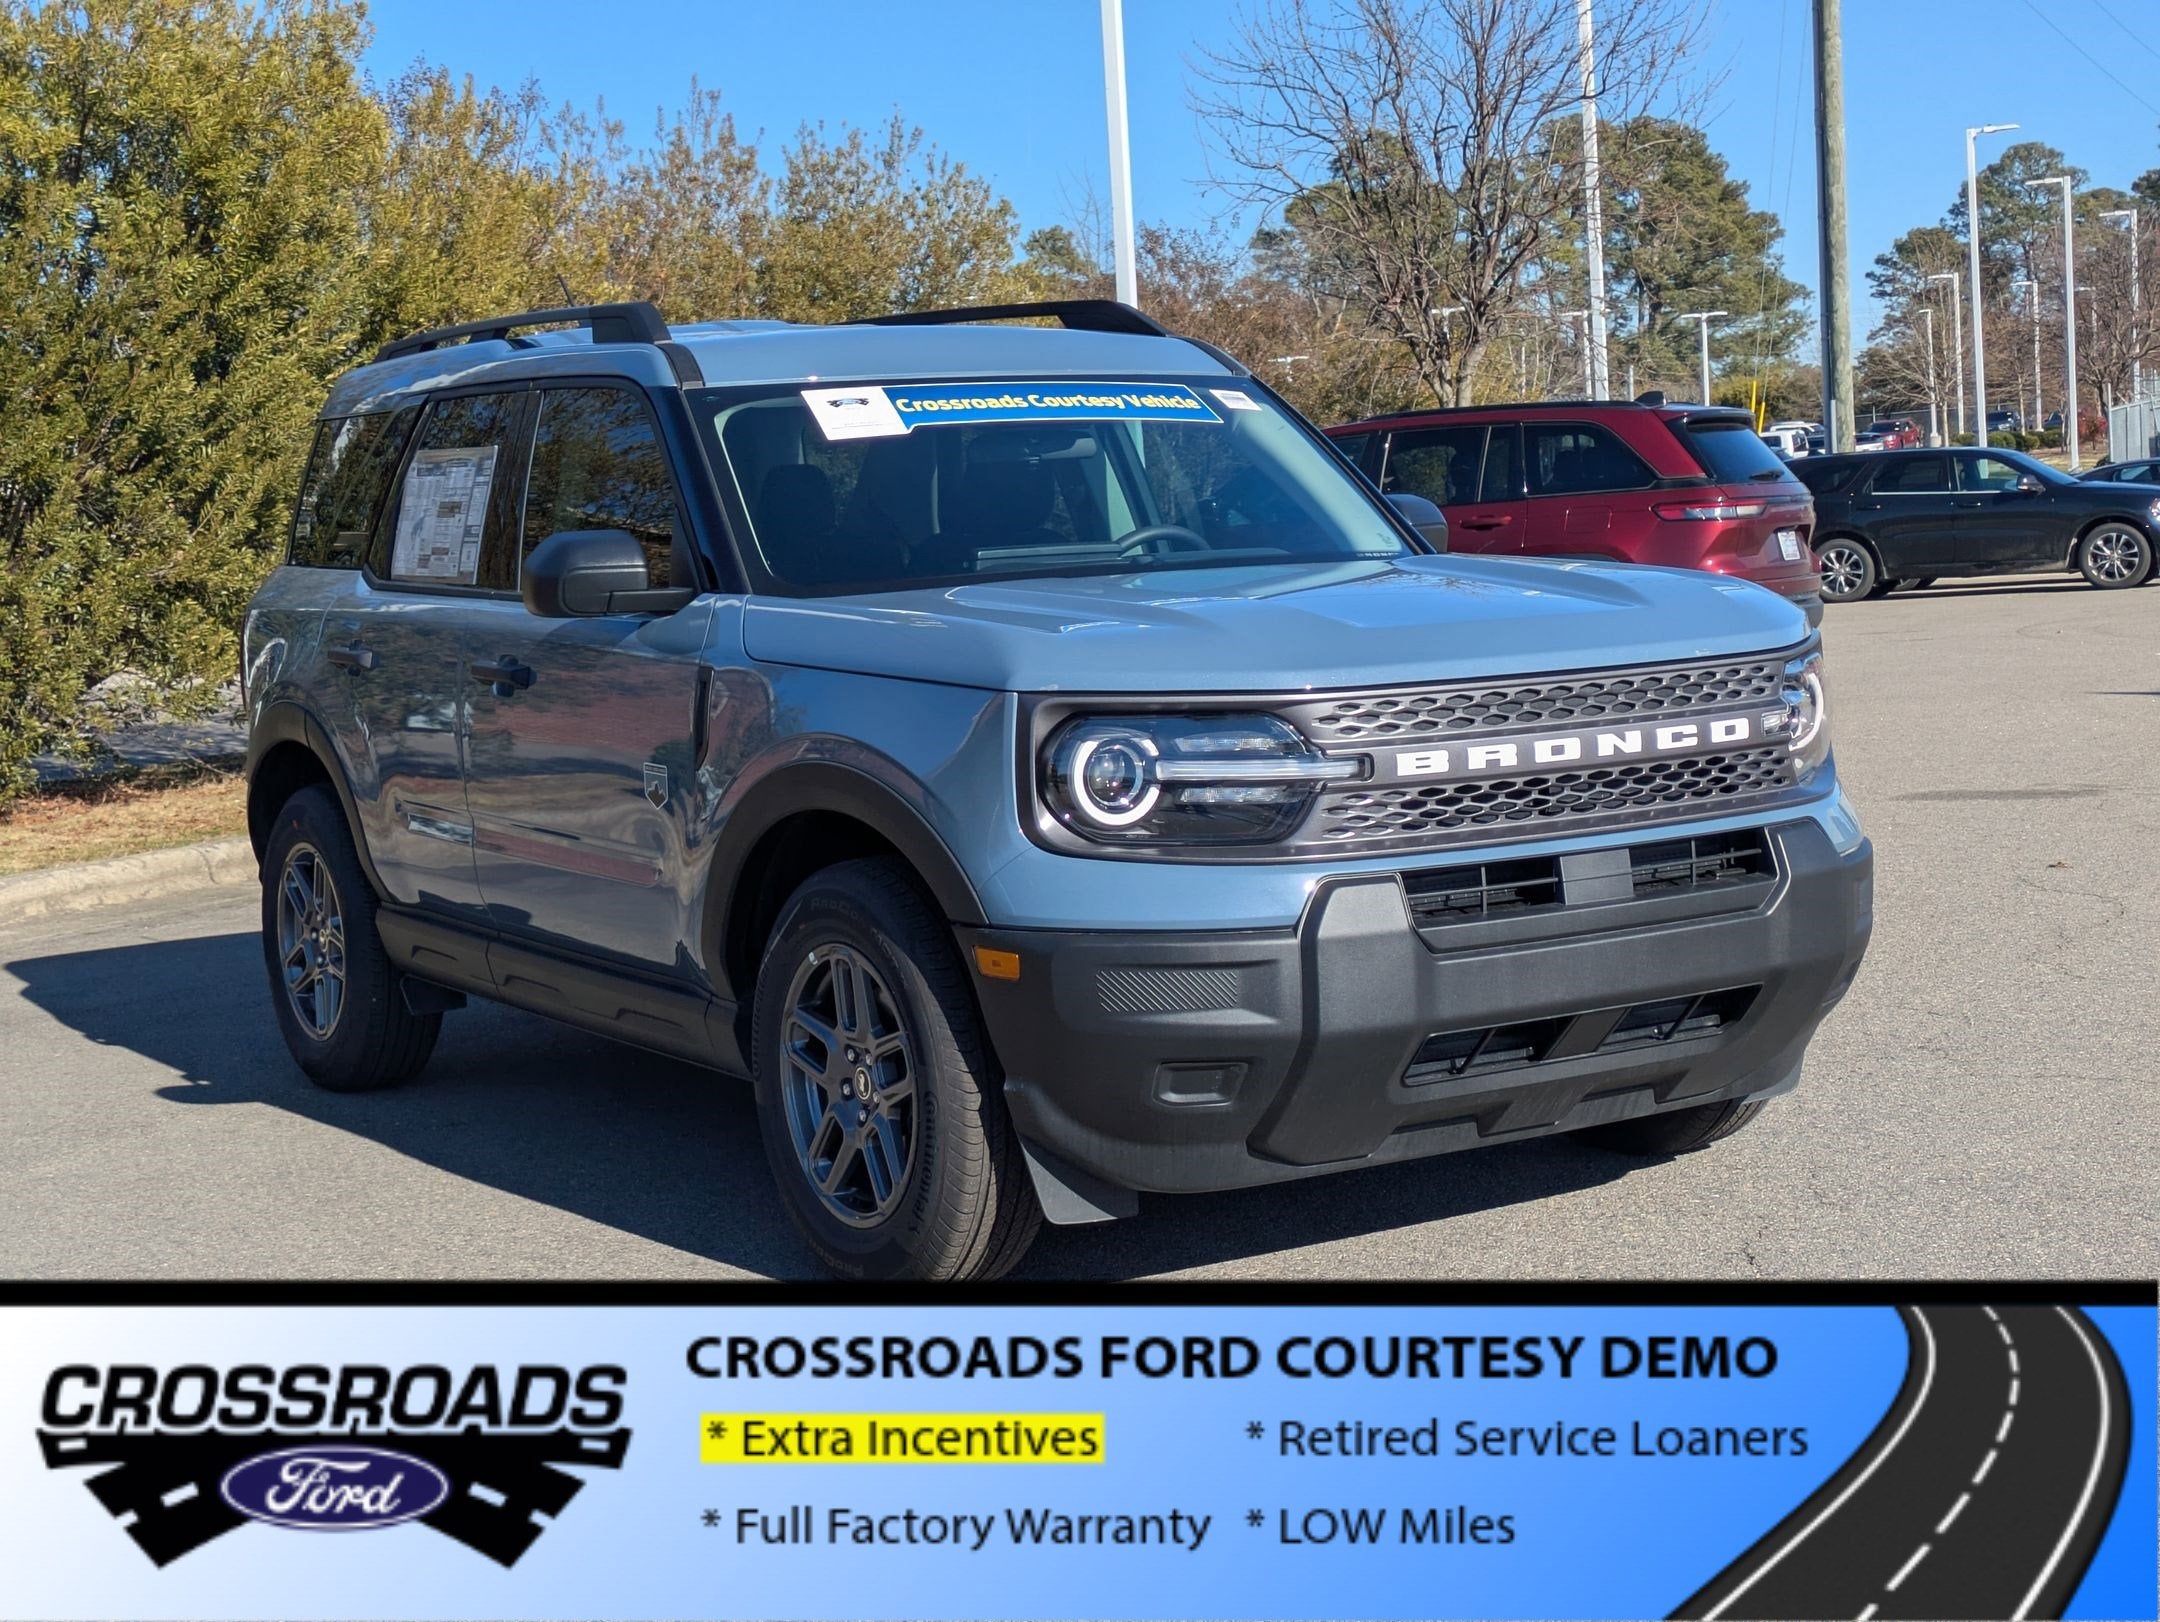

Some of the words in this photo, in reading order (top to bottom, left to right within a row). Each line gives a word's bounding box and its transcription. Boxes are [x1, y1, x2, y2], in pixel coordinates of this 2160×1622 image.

[896, 394, 1024, 412] Crossroads
[1028, 394, 1125, 409] Courtesy
[1123, 394, 1202, 409] Vehicle
[1396, 717, 1750, 776] BRONCO
